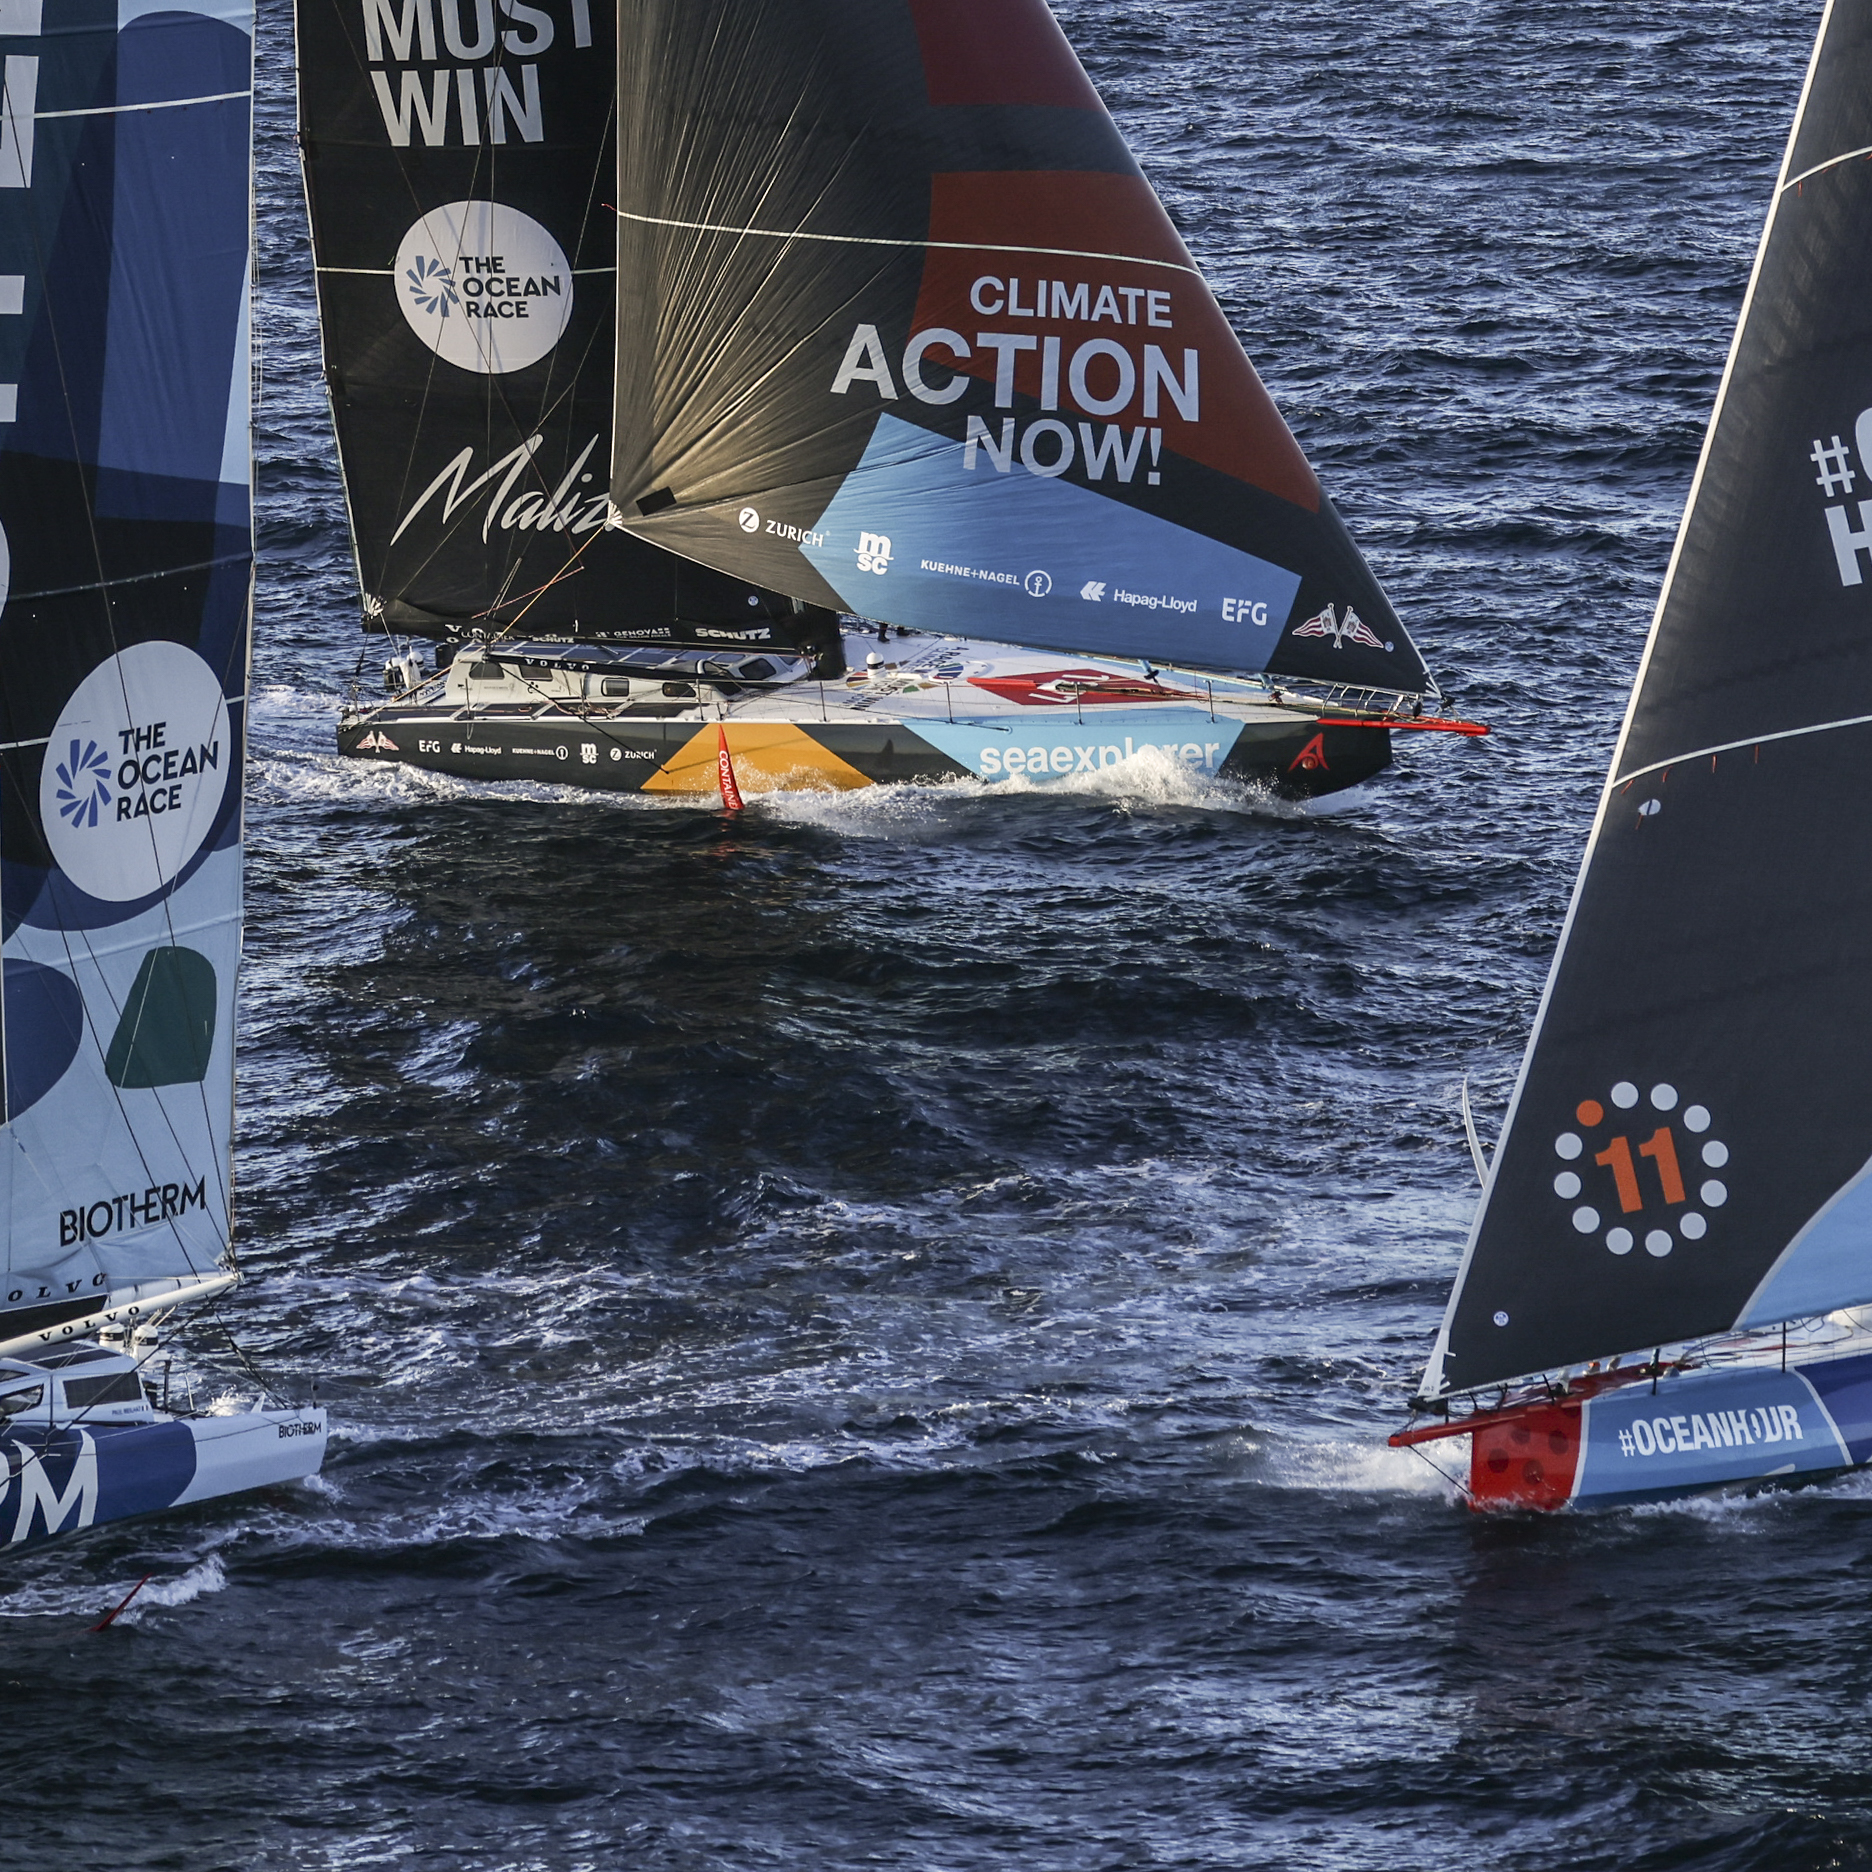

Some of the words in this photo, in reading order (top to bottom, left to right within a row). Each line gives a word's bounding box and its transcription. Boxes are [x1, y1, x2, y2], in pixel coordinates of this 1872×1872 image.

[370, 64, 544, 147] WIN
[460, 256, 505, 274] THE
[462, 275, 561, 297] OCEAN
[970, 275, 1172, 329] CLIMATE
[466, 300, 529, 319] RACE
[831, 324, 1199, 423] ACTION
[963, 415, 1163, 486] NOW!
[390, 433, 615, 545] Maliz
[765, 519, 824, 548] ZURICH
[920, 559, 1020, 586] KUEHNE+NAGEL
[1113, 588, 1198, 614] Hapag-Lloyd
[1221, 597, 1268, 627] EFG
[525, 658, 590, 672] VOLVO
[118, 723, 167, 756] THE
[418, 740, 440, 753] EFG
[980, 737, 1220, 774] seaexplrer
[117, 741, 220, 790] OCEAN
[116, 785, 183, 822] RACE
[1594, 1126, 1686, 1214] 11
[60, 1175, 205, 1247] BIOTHERM
[38, 1306, 140, 1342] VOLVO
[279, 1422, 322, 1439] BIOTHERM
[1618, 1403, 1803, 1457] #OCEANHOUR
